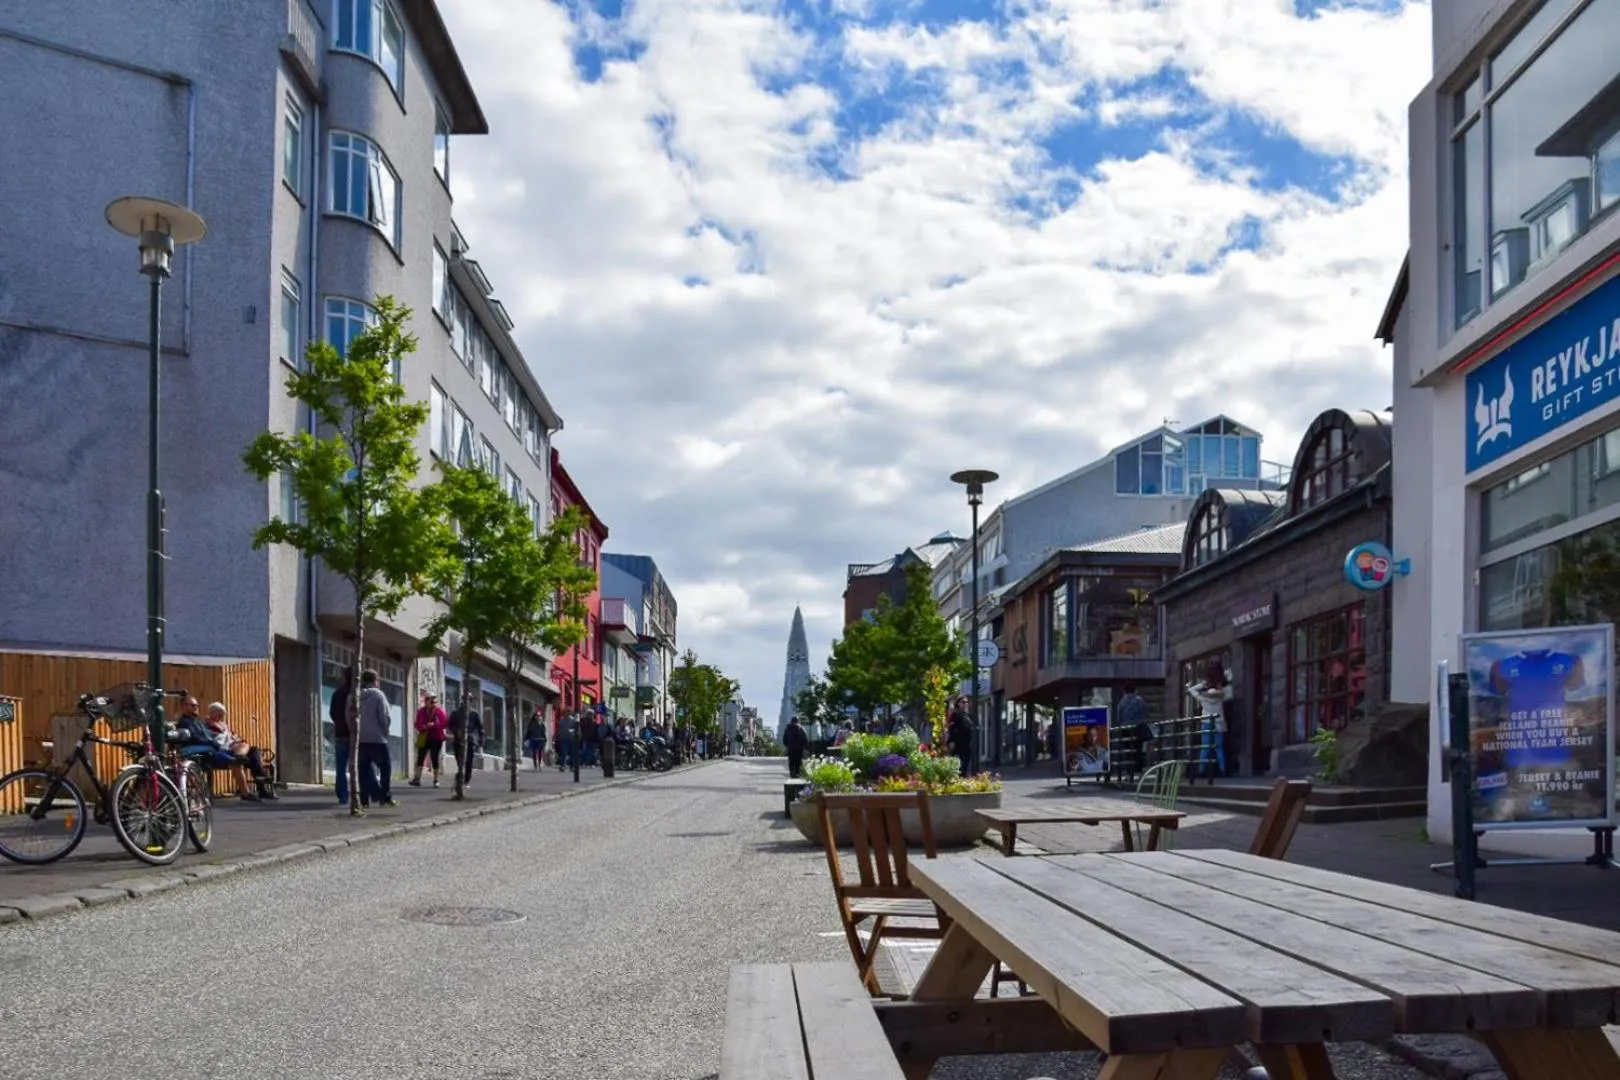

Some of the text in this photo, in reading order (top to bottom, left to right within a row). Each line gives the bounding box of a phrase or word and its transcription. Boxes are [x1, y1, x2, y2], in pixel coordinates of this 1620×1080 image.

[1543, 385, 1584, 421] GIFT
[1511, 709, 1562, 720] GET A FREE
[1496, 727, 1579, 740] WHEN YOU BUY A
[1482, 736, 1593, 751] NATIONAL TEAM JERSEY
[1519, 772, 1550, 782] JERSEY
[1565, 770, 1600, 780] BEANIE
